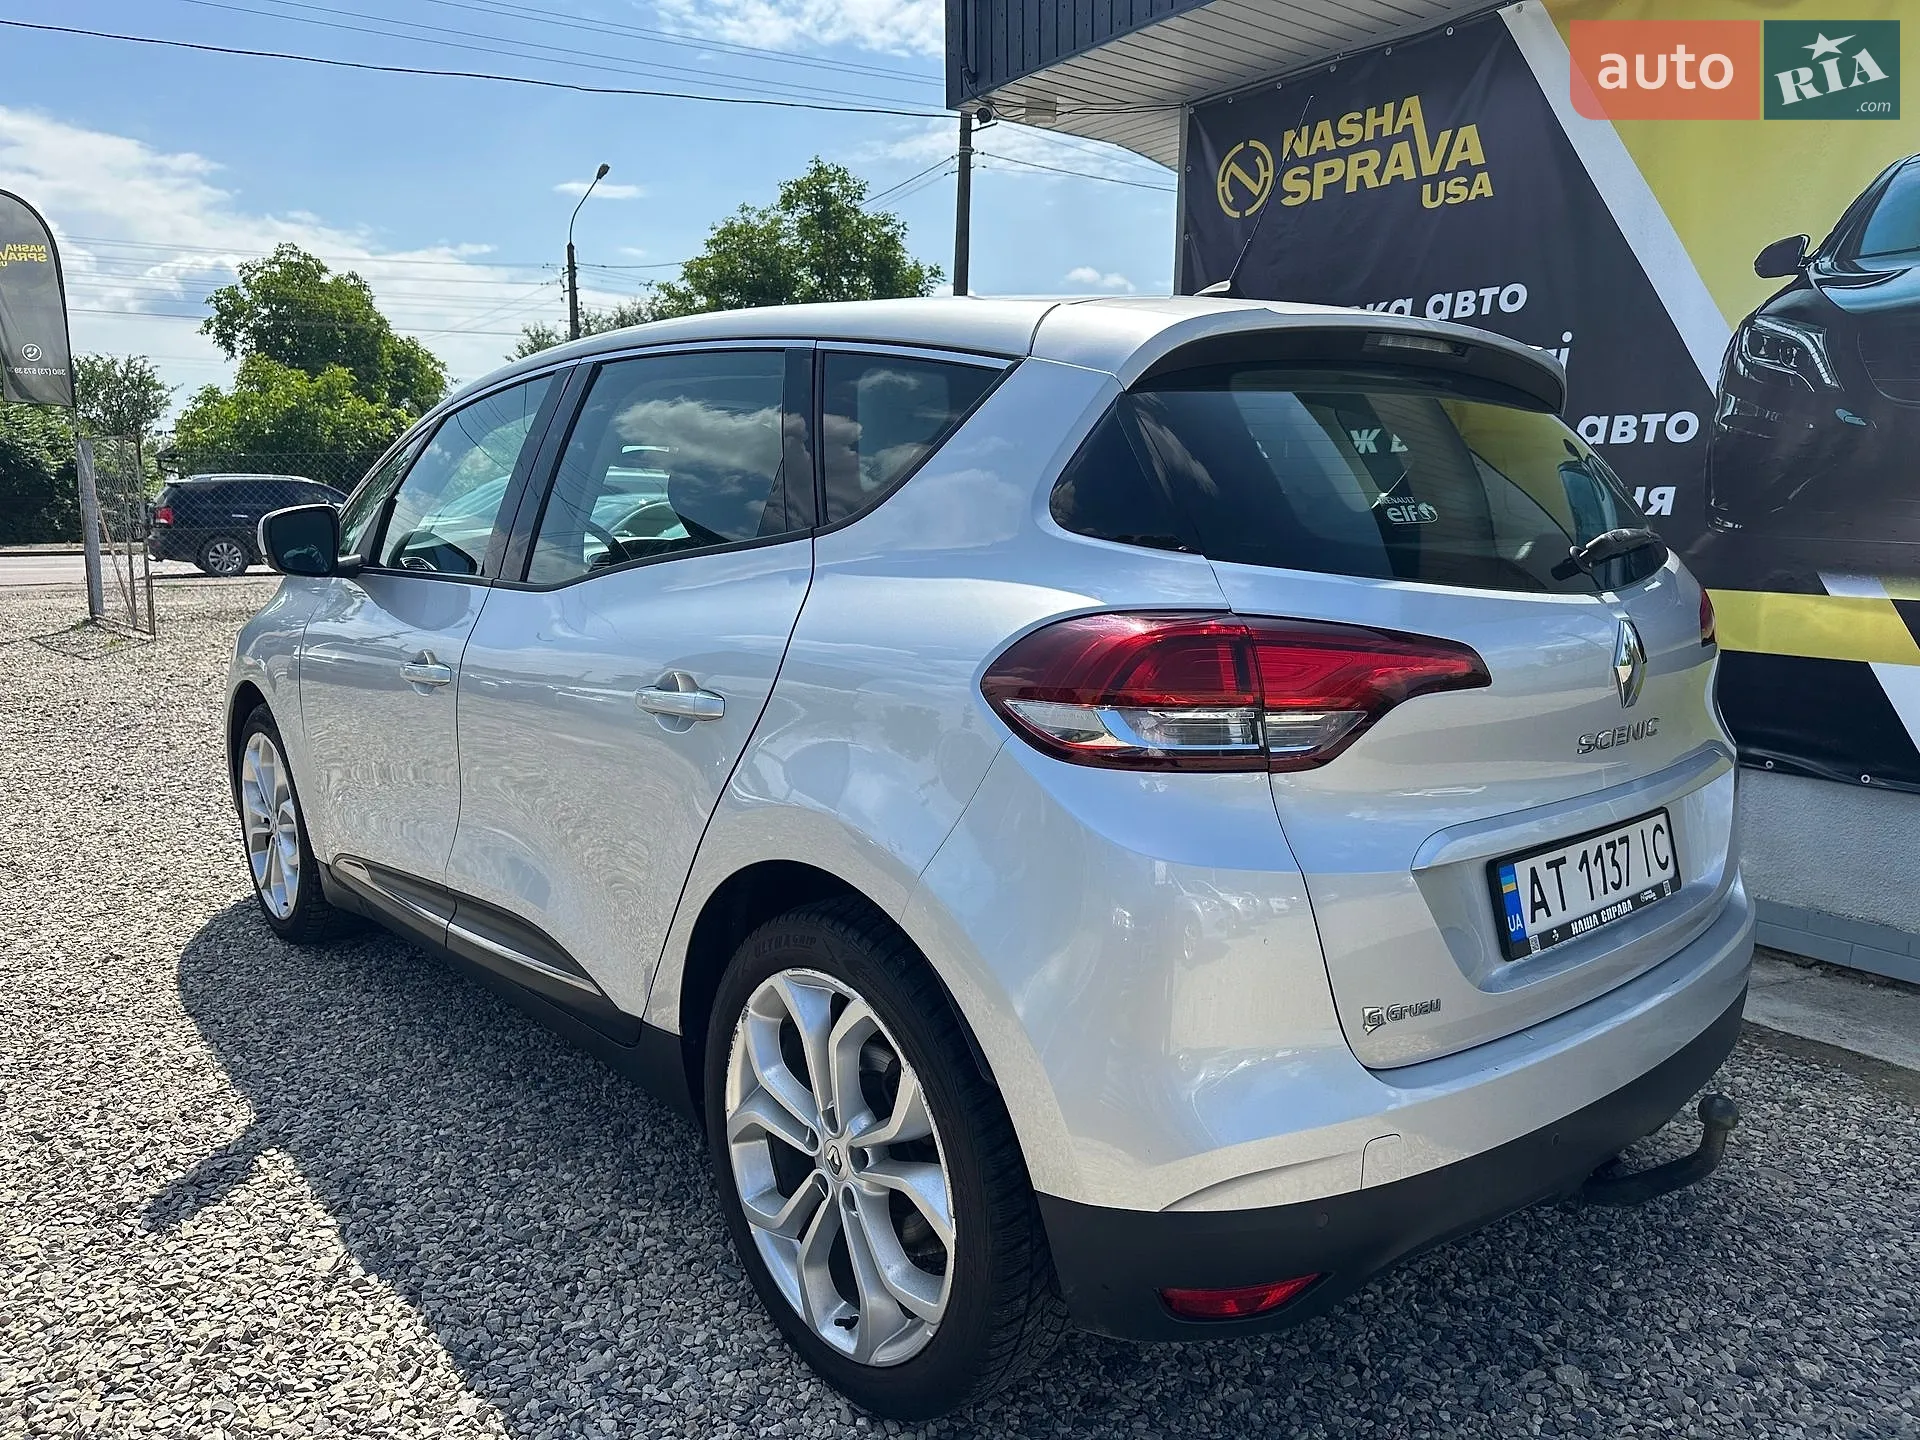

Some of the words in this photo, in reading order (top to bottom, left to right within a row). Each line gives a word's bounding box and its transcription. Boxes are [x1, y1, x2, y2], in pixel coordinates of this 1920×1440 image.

[1282, 95, 1421, 161] NASHA
[1281, 123, 1486, 207] SPRAVA
[1421, 171, 1494, 209] USA
[1425, 283, 1528, 320] авто
[1576, 411, 1699, 445] авто
[1577, 717, 1660, 755] SCENIC
[1529, 855, 1567, 924] AT
[1578, 834, 1630, 902] 1137
[1640, 823, 1670, 878] IC
[1507, 912, 1524, 932] UA
[1570, 912, 1600, 936] НАША
[1600, 899, 1634, 924] СПРАВА
